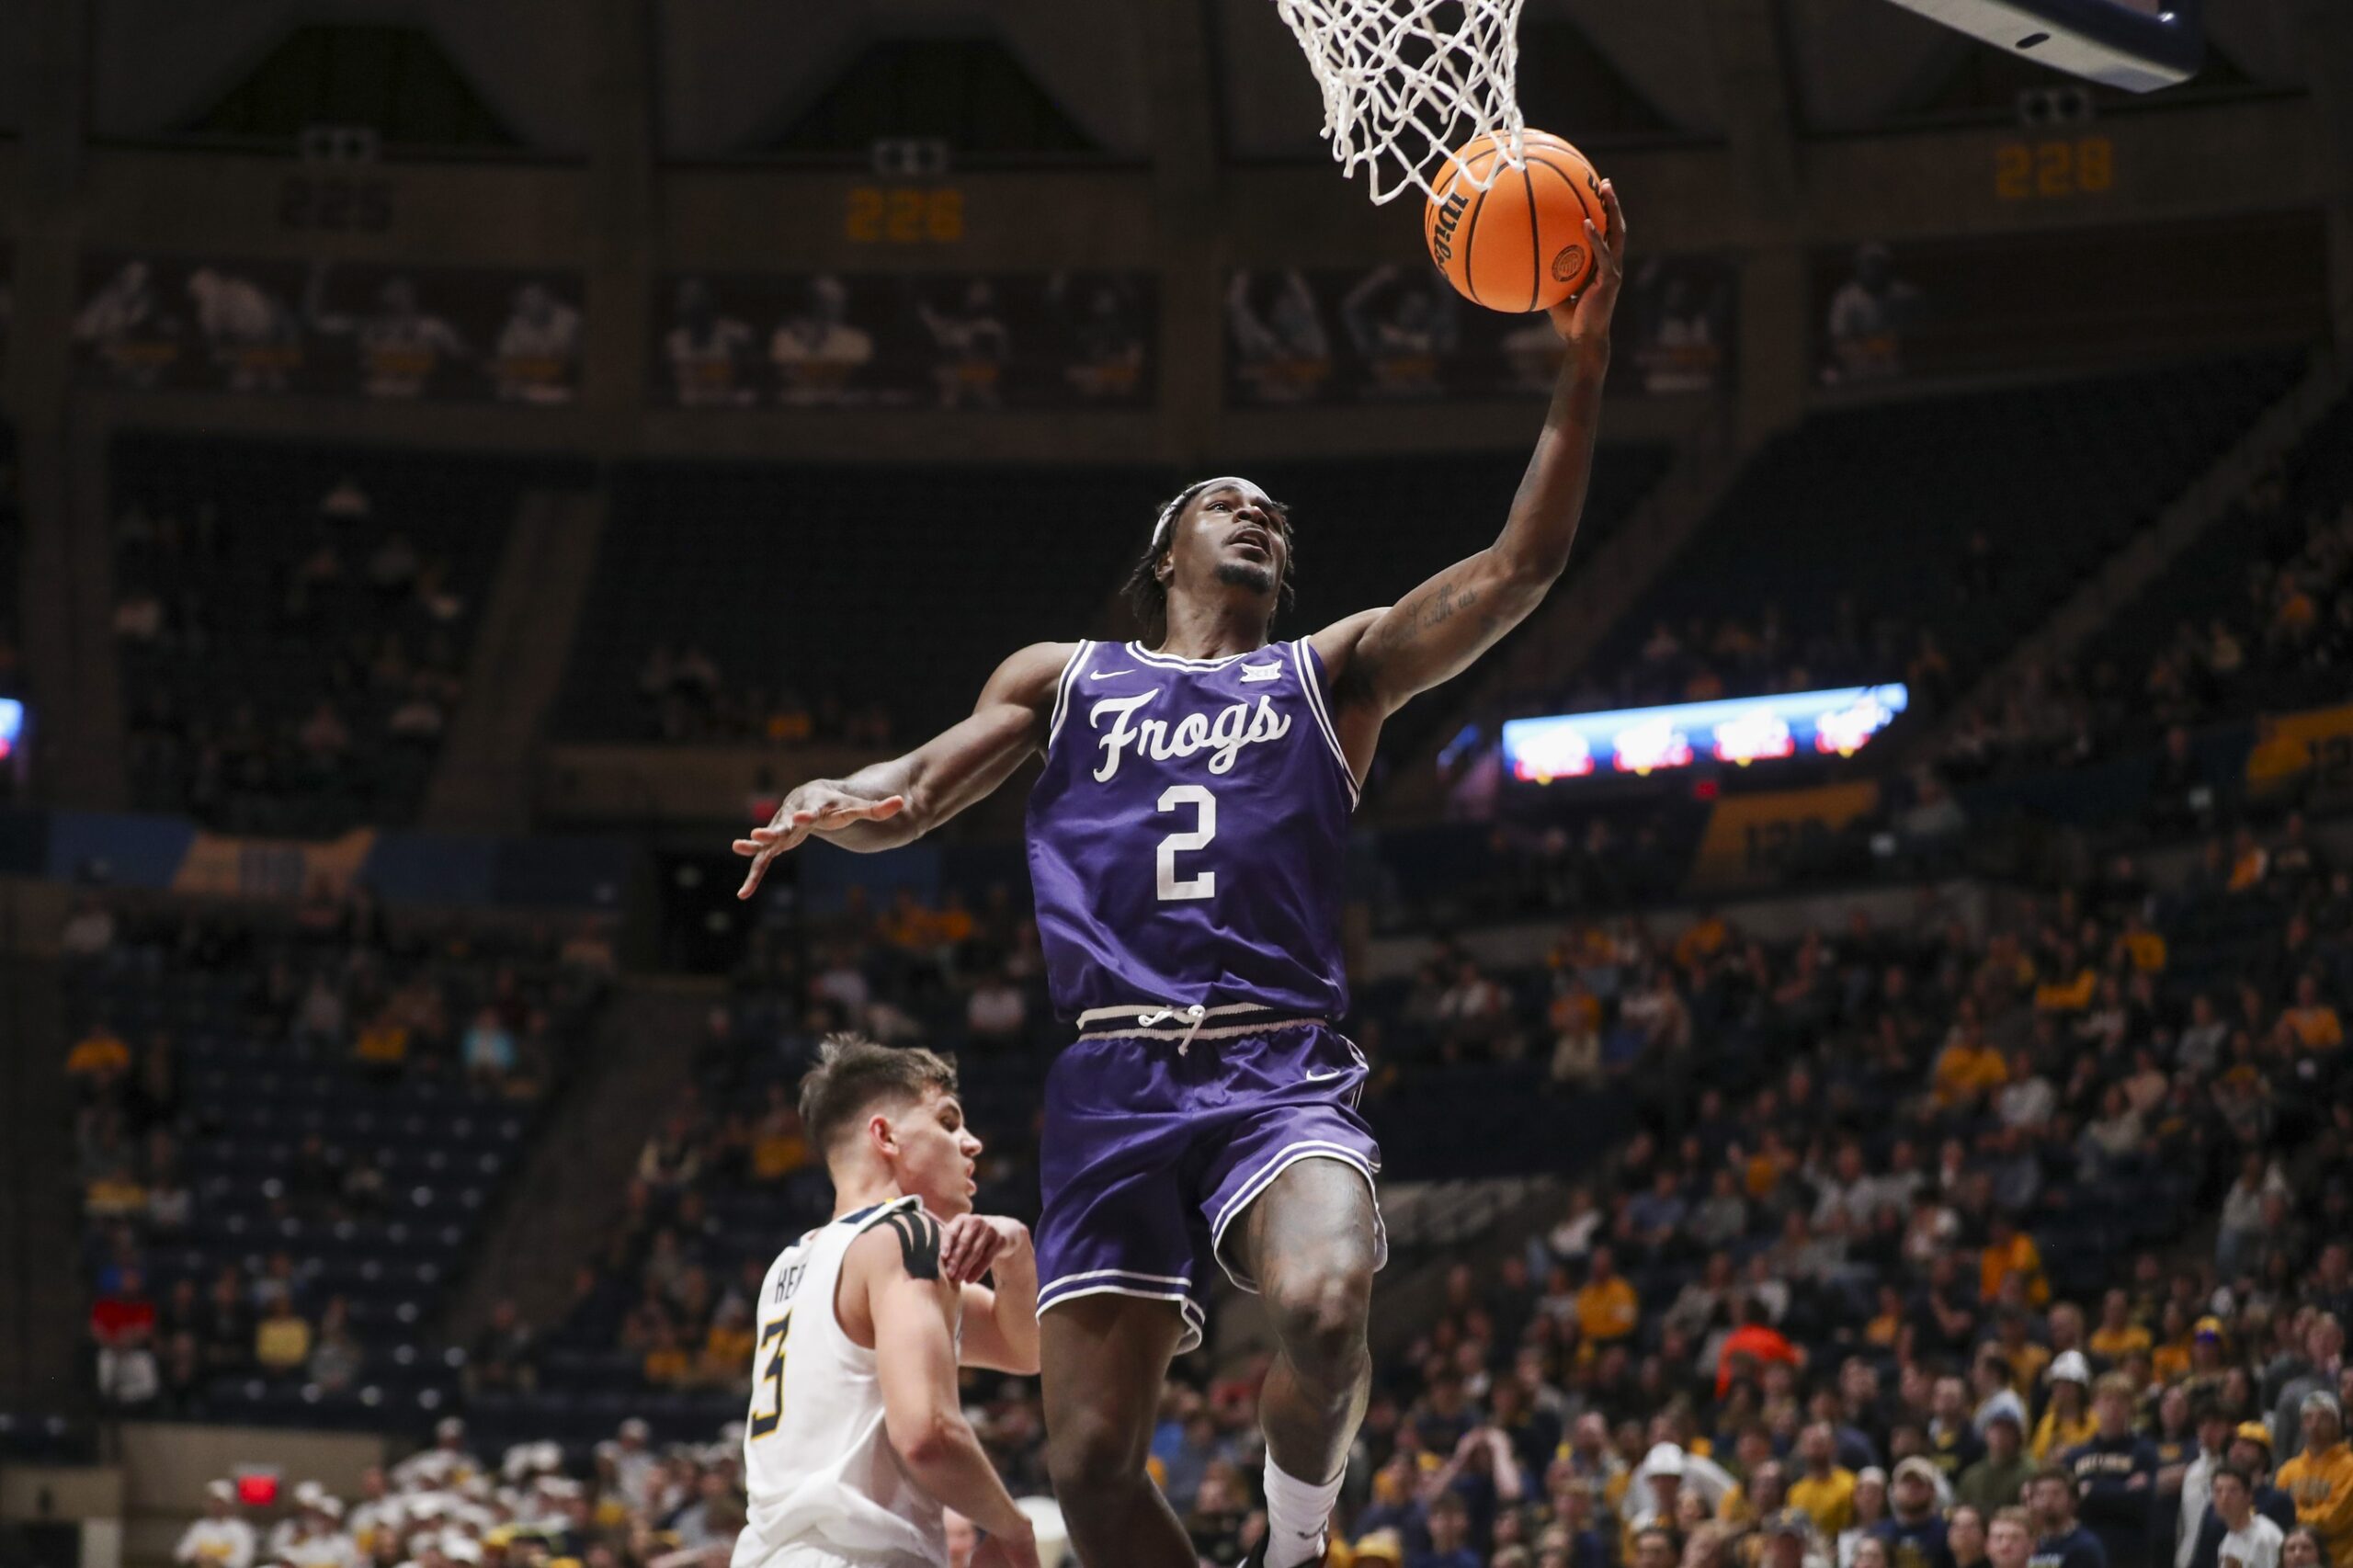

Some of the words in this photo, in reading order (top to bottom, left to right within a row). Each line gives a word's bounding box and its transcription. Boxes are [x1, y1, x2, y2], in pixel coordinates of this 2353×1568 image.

[1996, 139, 2112, 197] 228
[1458, 590, 1478, 608] us
[1090, 688, 1291, 782] Frogs
[1157, 785, 1216, 901] 2
[750, 1307, 793, 1441] 3
